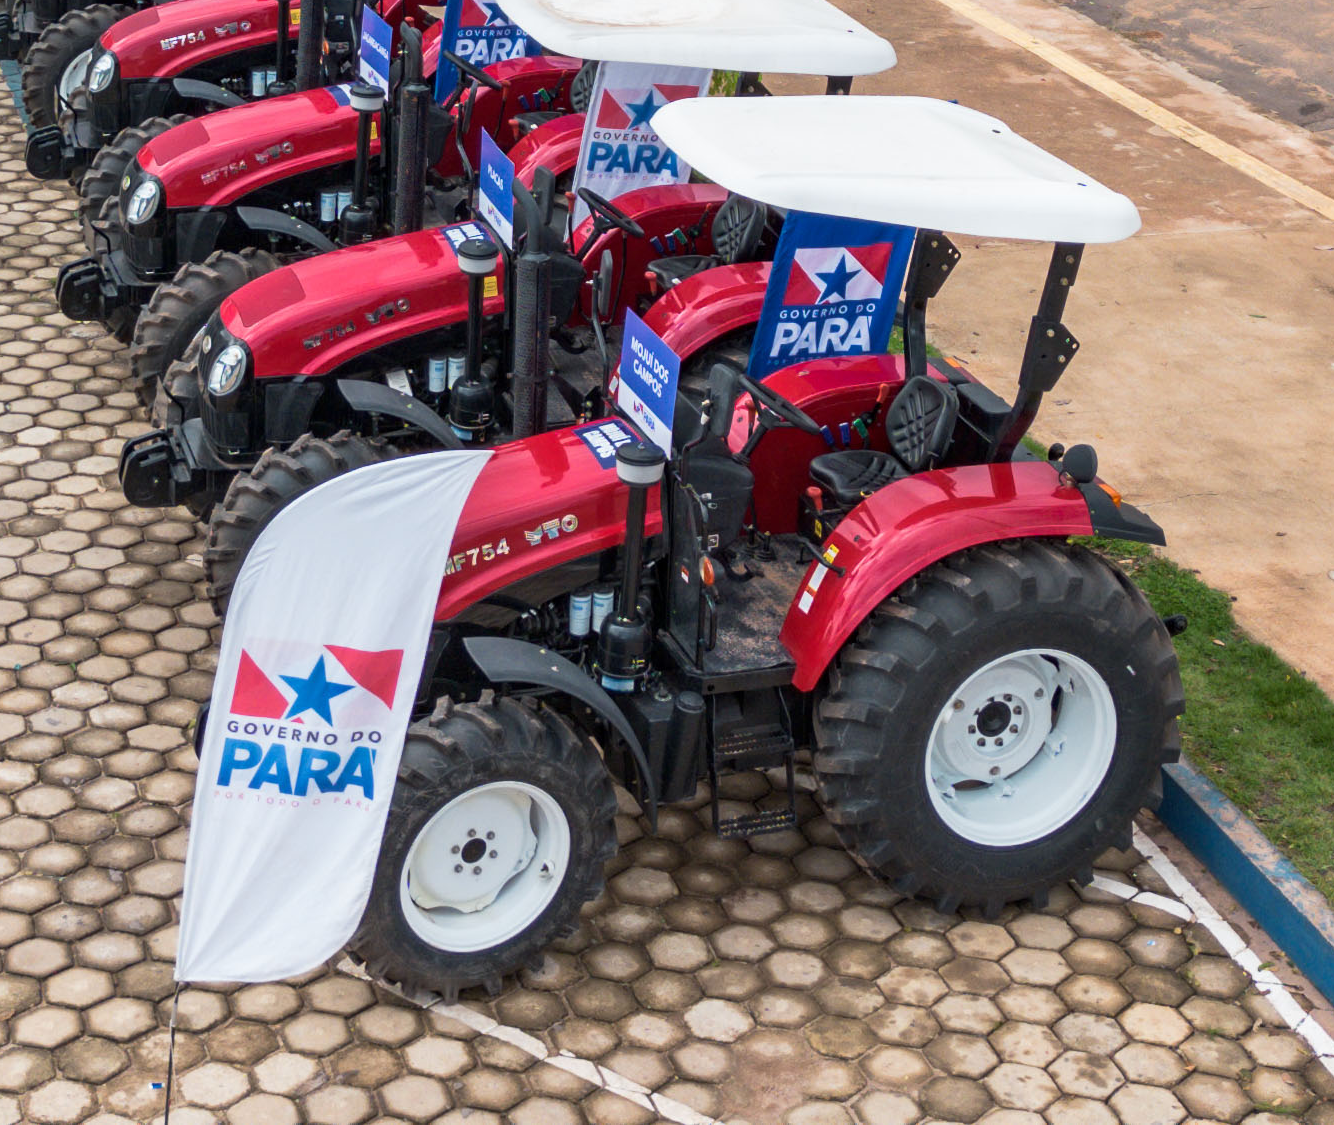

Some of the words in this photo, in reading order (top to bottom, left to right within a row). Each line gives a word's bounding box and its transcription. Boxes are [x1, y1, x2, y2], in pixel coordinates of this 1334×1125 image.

[457, 28, 511, 38] GOVERNO
[593, 131, 659, 143] GOVERNO
[779, 304, 848, 319] GOVERNO
[856, 303, 875, 314] DO
[631, 336, 655, 371] MOJUÍ
[654, 360, 669, 384] DOS
[633, 359, 663, 398] CAMPOS
[443, 538, 510, 577] MF754
[226, 720, 338, 745] GOVERNO
[350, 730, 382, 744] DO
[256, 796, 300, 808] TODO
